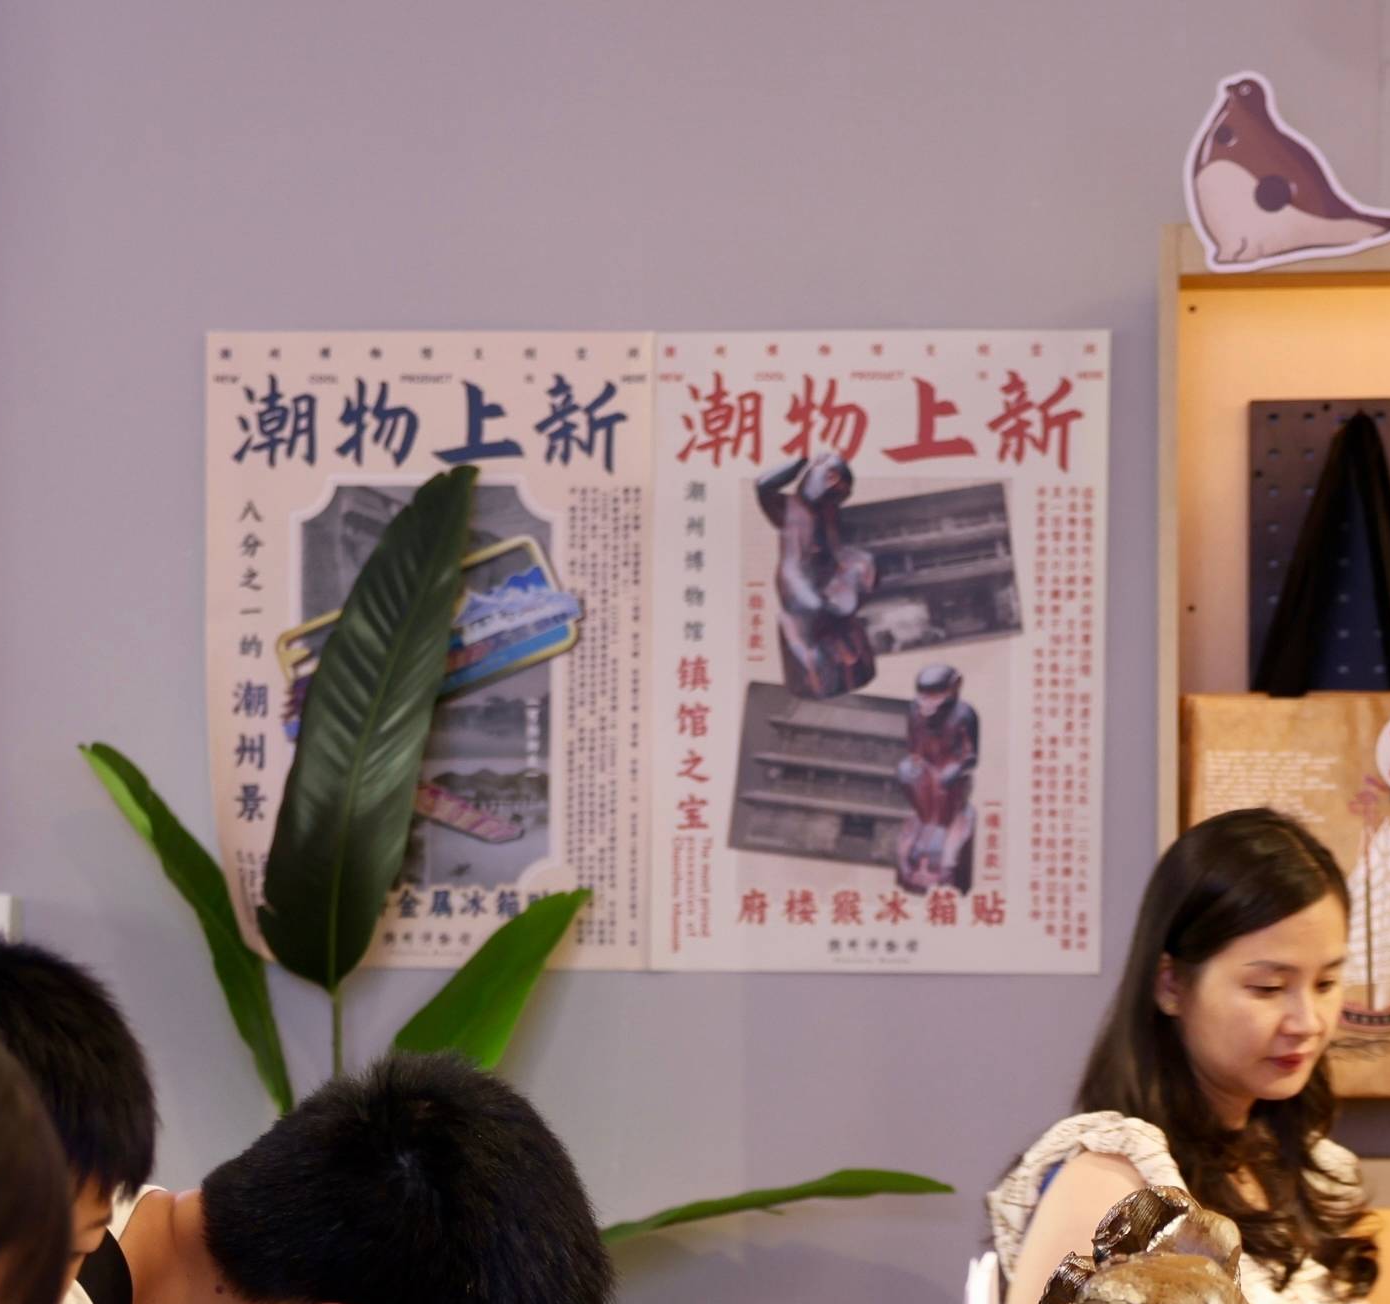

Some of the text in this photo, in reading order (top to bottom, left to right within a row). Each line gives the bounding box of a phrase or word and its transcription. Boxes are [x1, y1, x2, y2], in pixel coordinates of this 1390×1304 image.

[232, 372, 628, 475] 潮物上新
[675, 369, 1085, 474] 潮物上新
[234, 500, 270, 822] 八分之一的潮州景
[676, 656, 711, 831] 镇馆之宝
[378, 888, 550, 919] 金属冰箱
